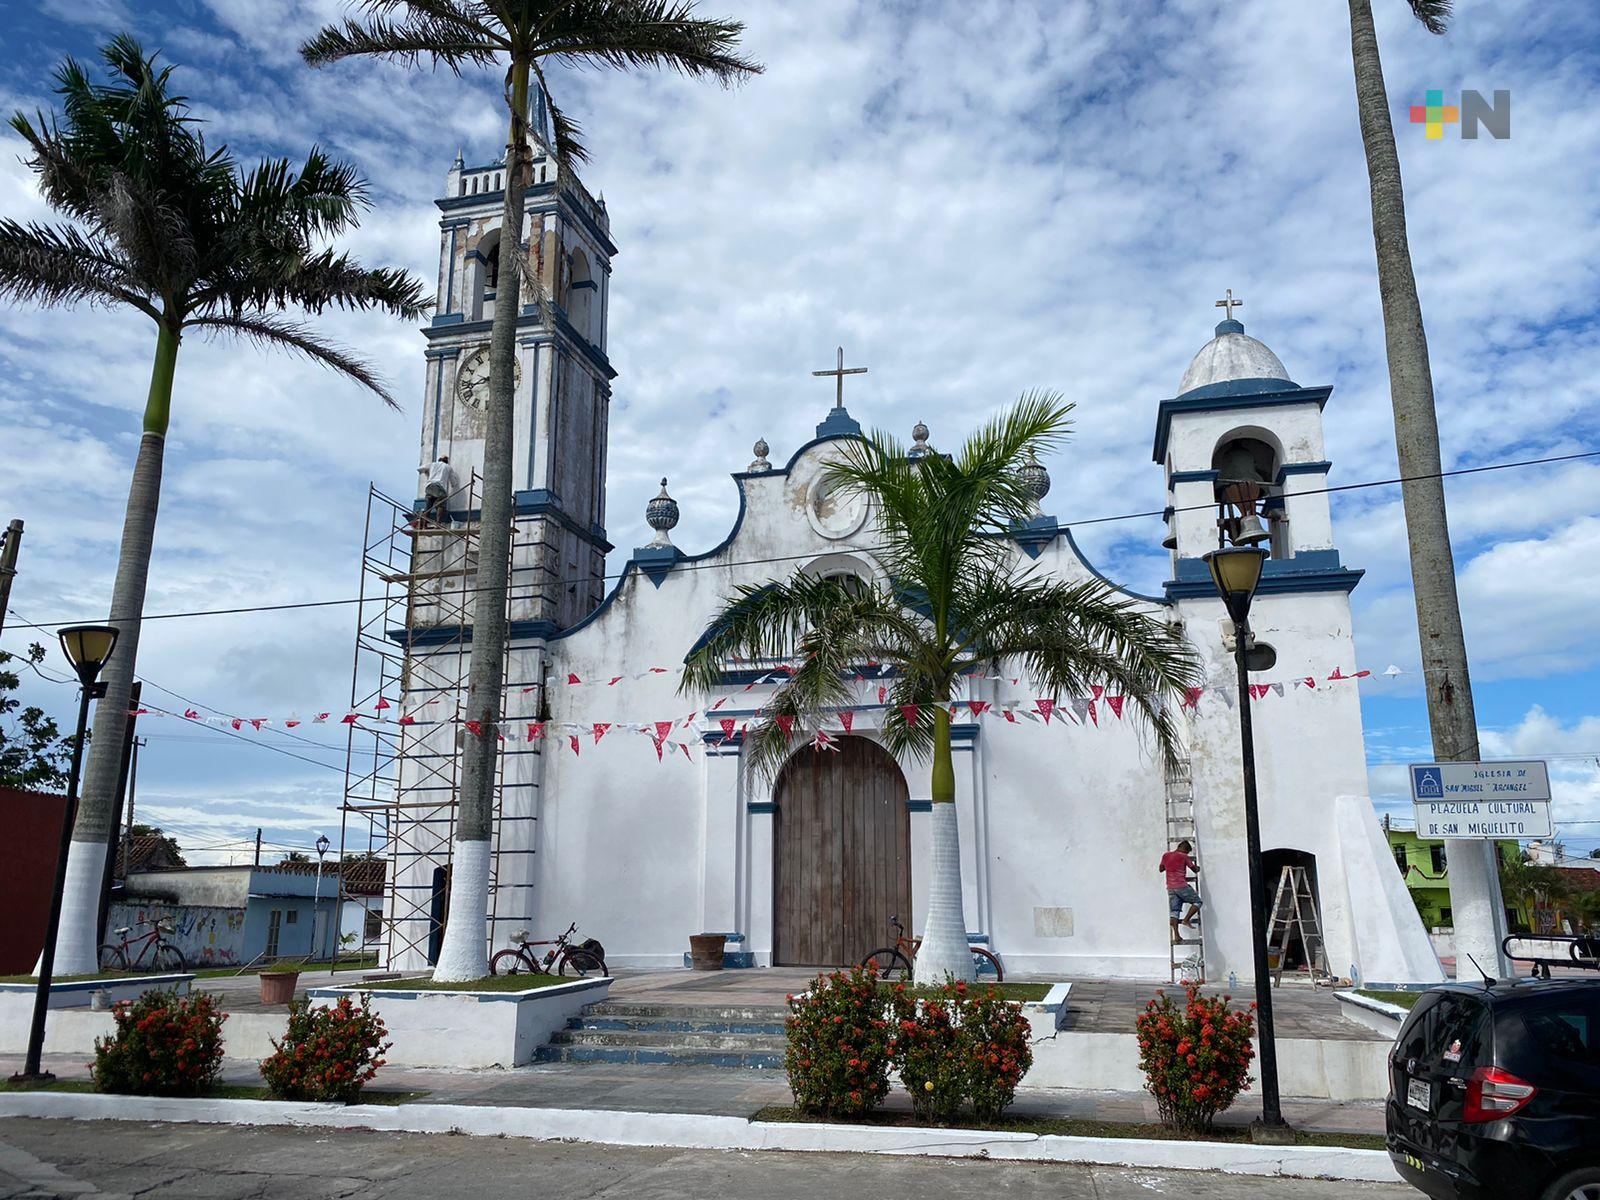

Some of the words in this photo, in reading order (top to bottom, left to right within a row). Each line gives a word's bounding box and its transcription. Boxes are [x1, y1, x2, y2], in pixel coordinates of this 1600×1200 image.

[1473, 769, 1511, 778] IGLESIA
[1517, 769, 1527, 777] DE
[1445, 783, 1459, 792] SAN
[1430, 803, 1479, 814] PLAZUELA
[1488, 802, 1536, 814] CULTURAL
[1429, 823, 1438, 834] DE
[1442, 823, 1458, 834] SAN
[1468, 822, 1524, 834] MIGUELITO
